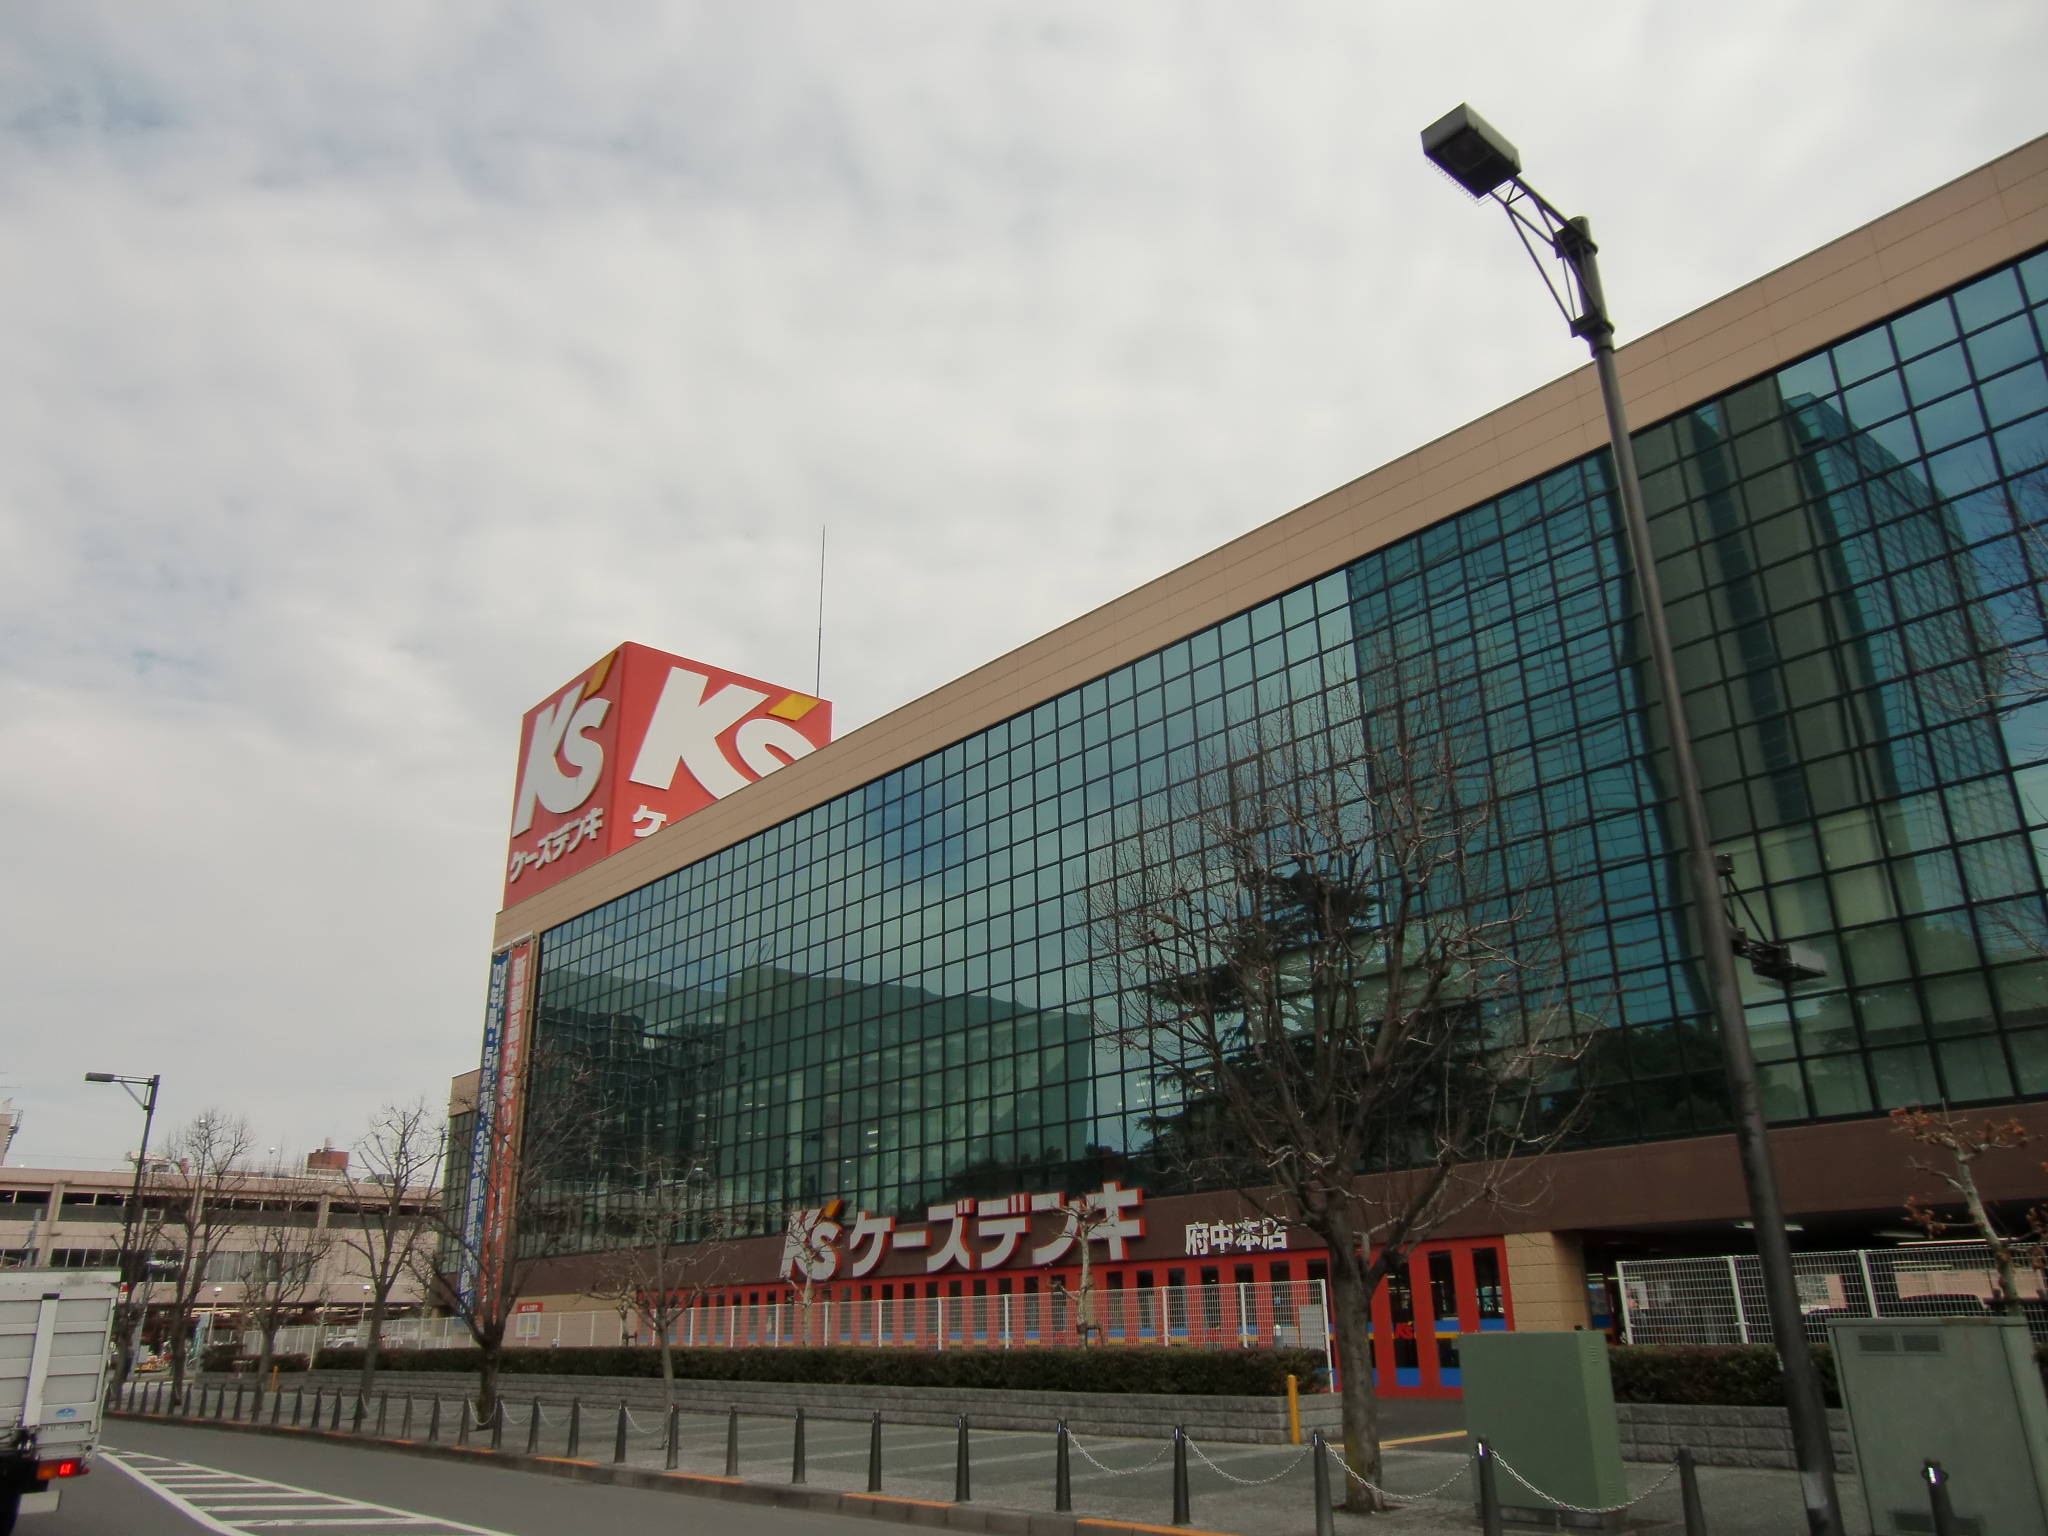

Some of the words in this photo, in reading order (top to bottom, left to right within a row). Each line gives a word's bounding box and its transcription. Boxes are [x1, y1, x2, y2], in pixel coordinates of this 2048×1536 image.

[632, 804, 670, 837] ケ
[780, 1199, 843, 1281] K's
[850, 1181, 1145, 1280] ケーズデンキ
[1185, 1217, 1288, 1256] 府中本店
